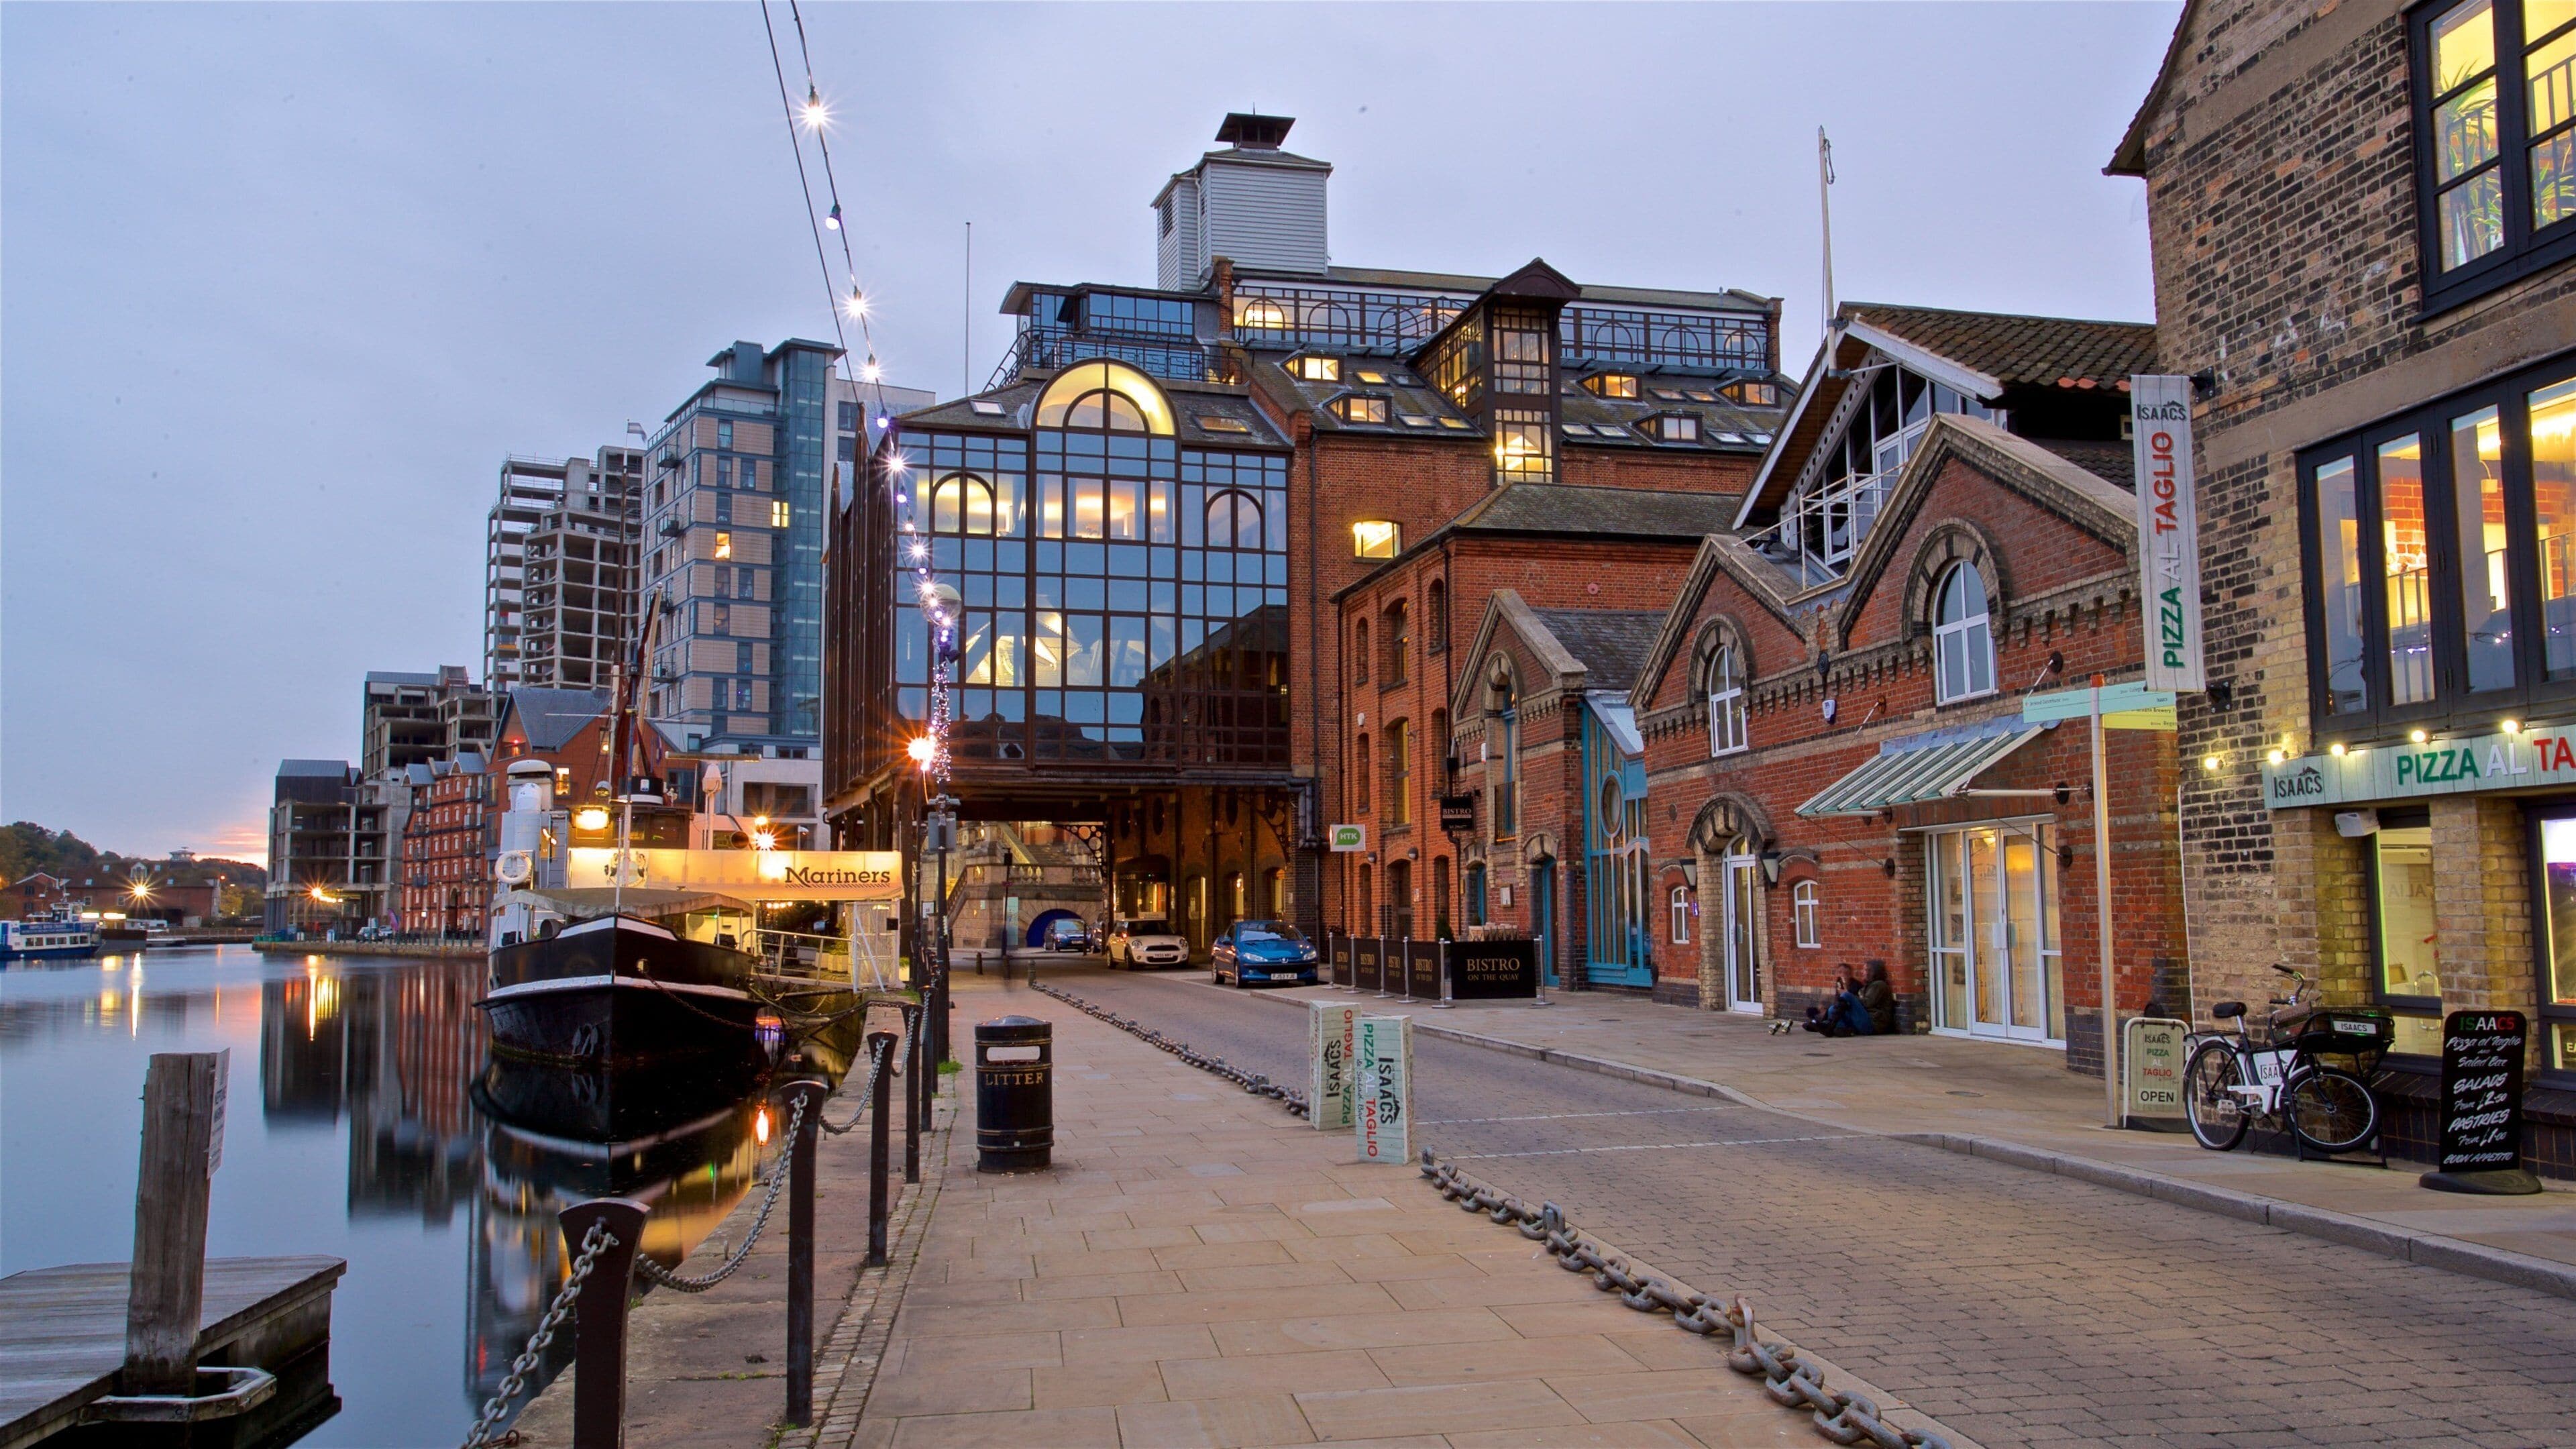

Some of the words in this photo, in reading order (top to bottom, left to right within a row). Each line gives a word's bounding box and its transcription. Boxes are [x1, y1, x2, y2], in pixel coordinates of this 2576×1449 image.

[2137, 404, 2186, 421] ISAACS
[2151, 431, 2178, 535] TAGLIO
[2158, 539, 2180, 583] AL
[2159, 587, 2184, 669] PIZZA
[2397, 748, 2479, 785] PIZZA
[2485, 743, 2528, 777] AL
[2534, 737, 2576, 771] TA
[2273, 775, 2322, 798] ISAACS
[785, 866, 891, 885] Mariners
[1466, 958, 1520, 971] BISTRO
[1499, 973, 1519, 981] QUAY
[2341, 1023, 2367, 1032] ISAACS
[2459, 1017, 2515, 1030] ISAACS
[1344, 1009, 1353, 1061] TAGLIO
[2145, 1034, 2171, 1044] ISAACS
[1364, 1024, 1375, 1069] PIZZA
[2147, 1048, 2169, 1057] PIZZA
[985, 1072, 1044, 1085] LITTER
[1326, 1040, 1341, 1097] ISAACS
[1344, 1063, 1352, 1081] AL
[2143, 1068, 2172, 1077] TAGLIO
[1365, 1072, 1375, 1093] AL
[1379, 1058, 1394, 1124] ISAACS
[2453, 1073, 2508, 1094] SALADS
[1342, 1085, 1352, 1124] PIZZA
[2141, 1091, 2174, 1102] OPEN
[1366, 1098, 1378, 1157] TAGLIO
[2447, 1109, 2510, 1132] PASTRIES
